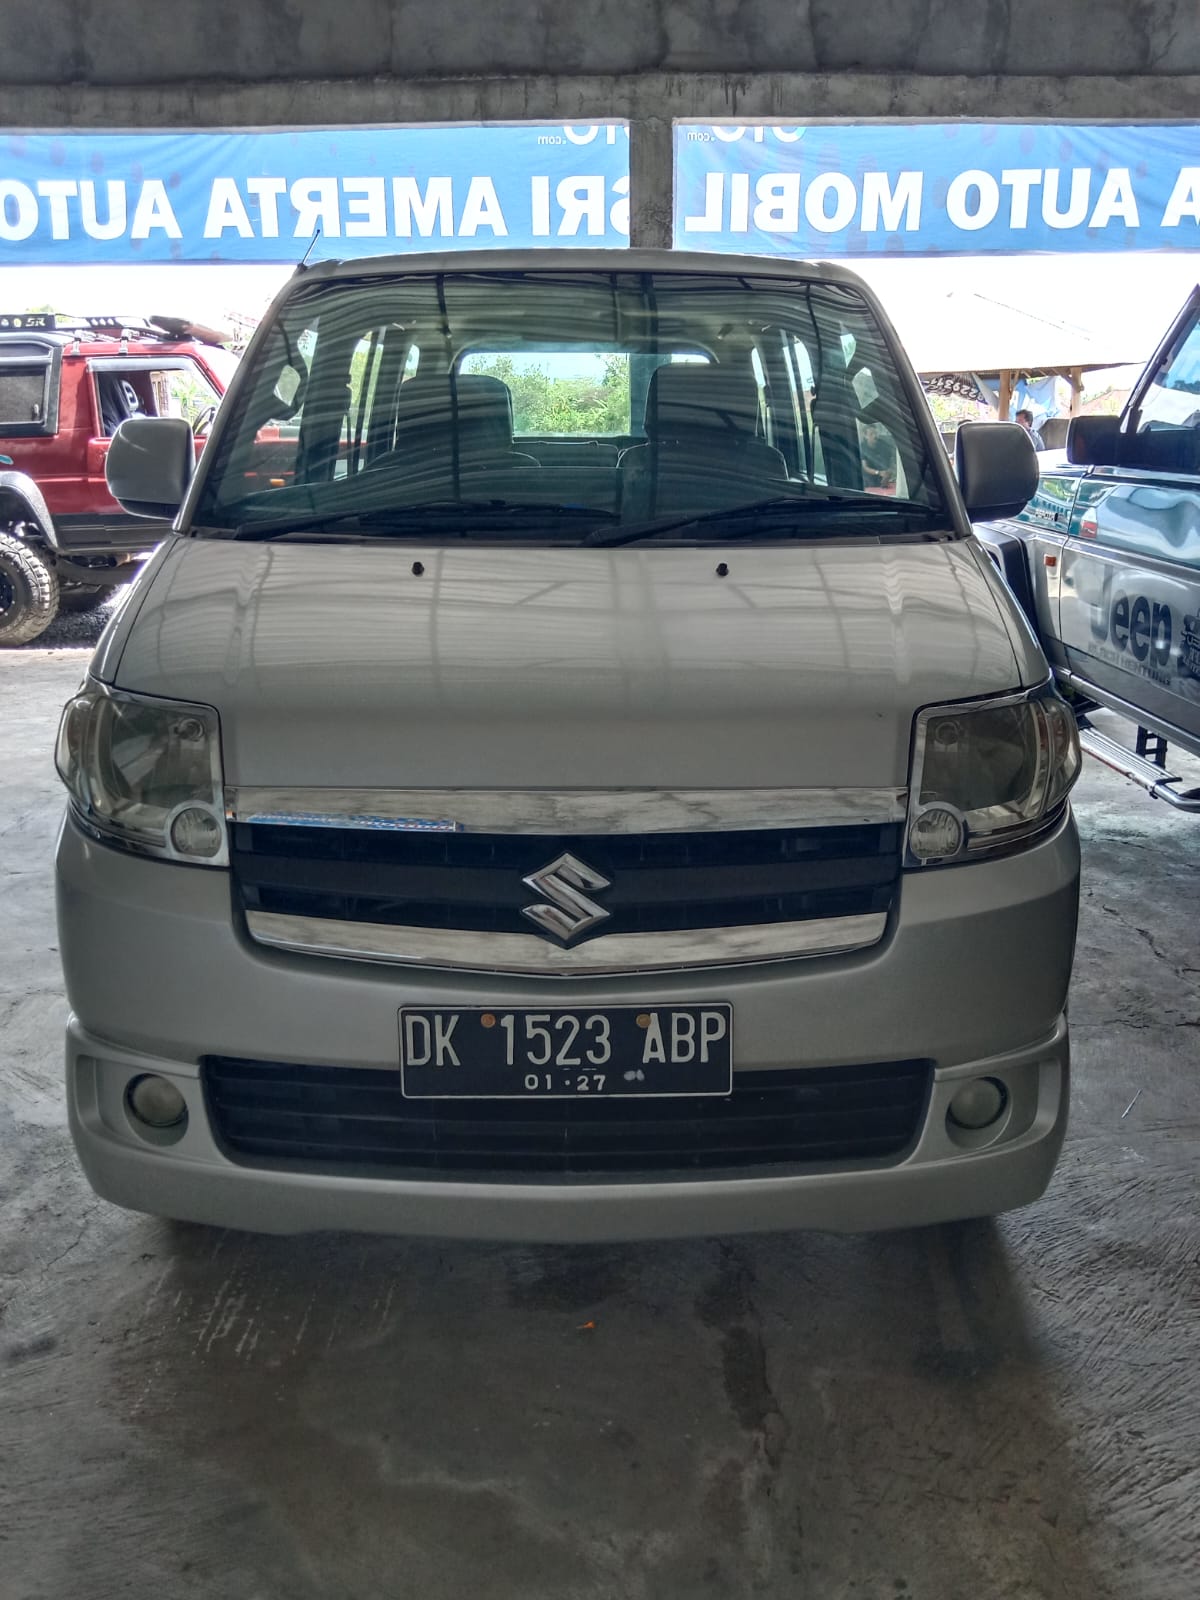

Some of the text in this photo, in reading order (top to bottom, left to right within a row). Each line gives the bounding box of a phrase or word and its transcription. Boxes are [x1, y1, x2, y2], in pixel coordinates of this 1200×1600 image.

[405, 1011, 727, 1067] DK 1523 ABP
